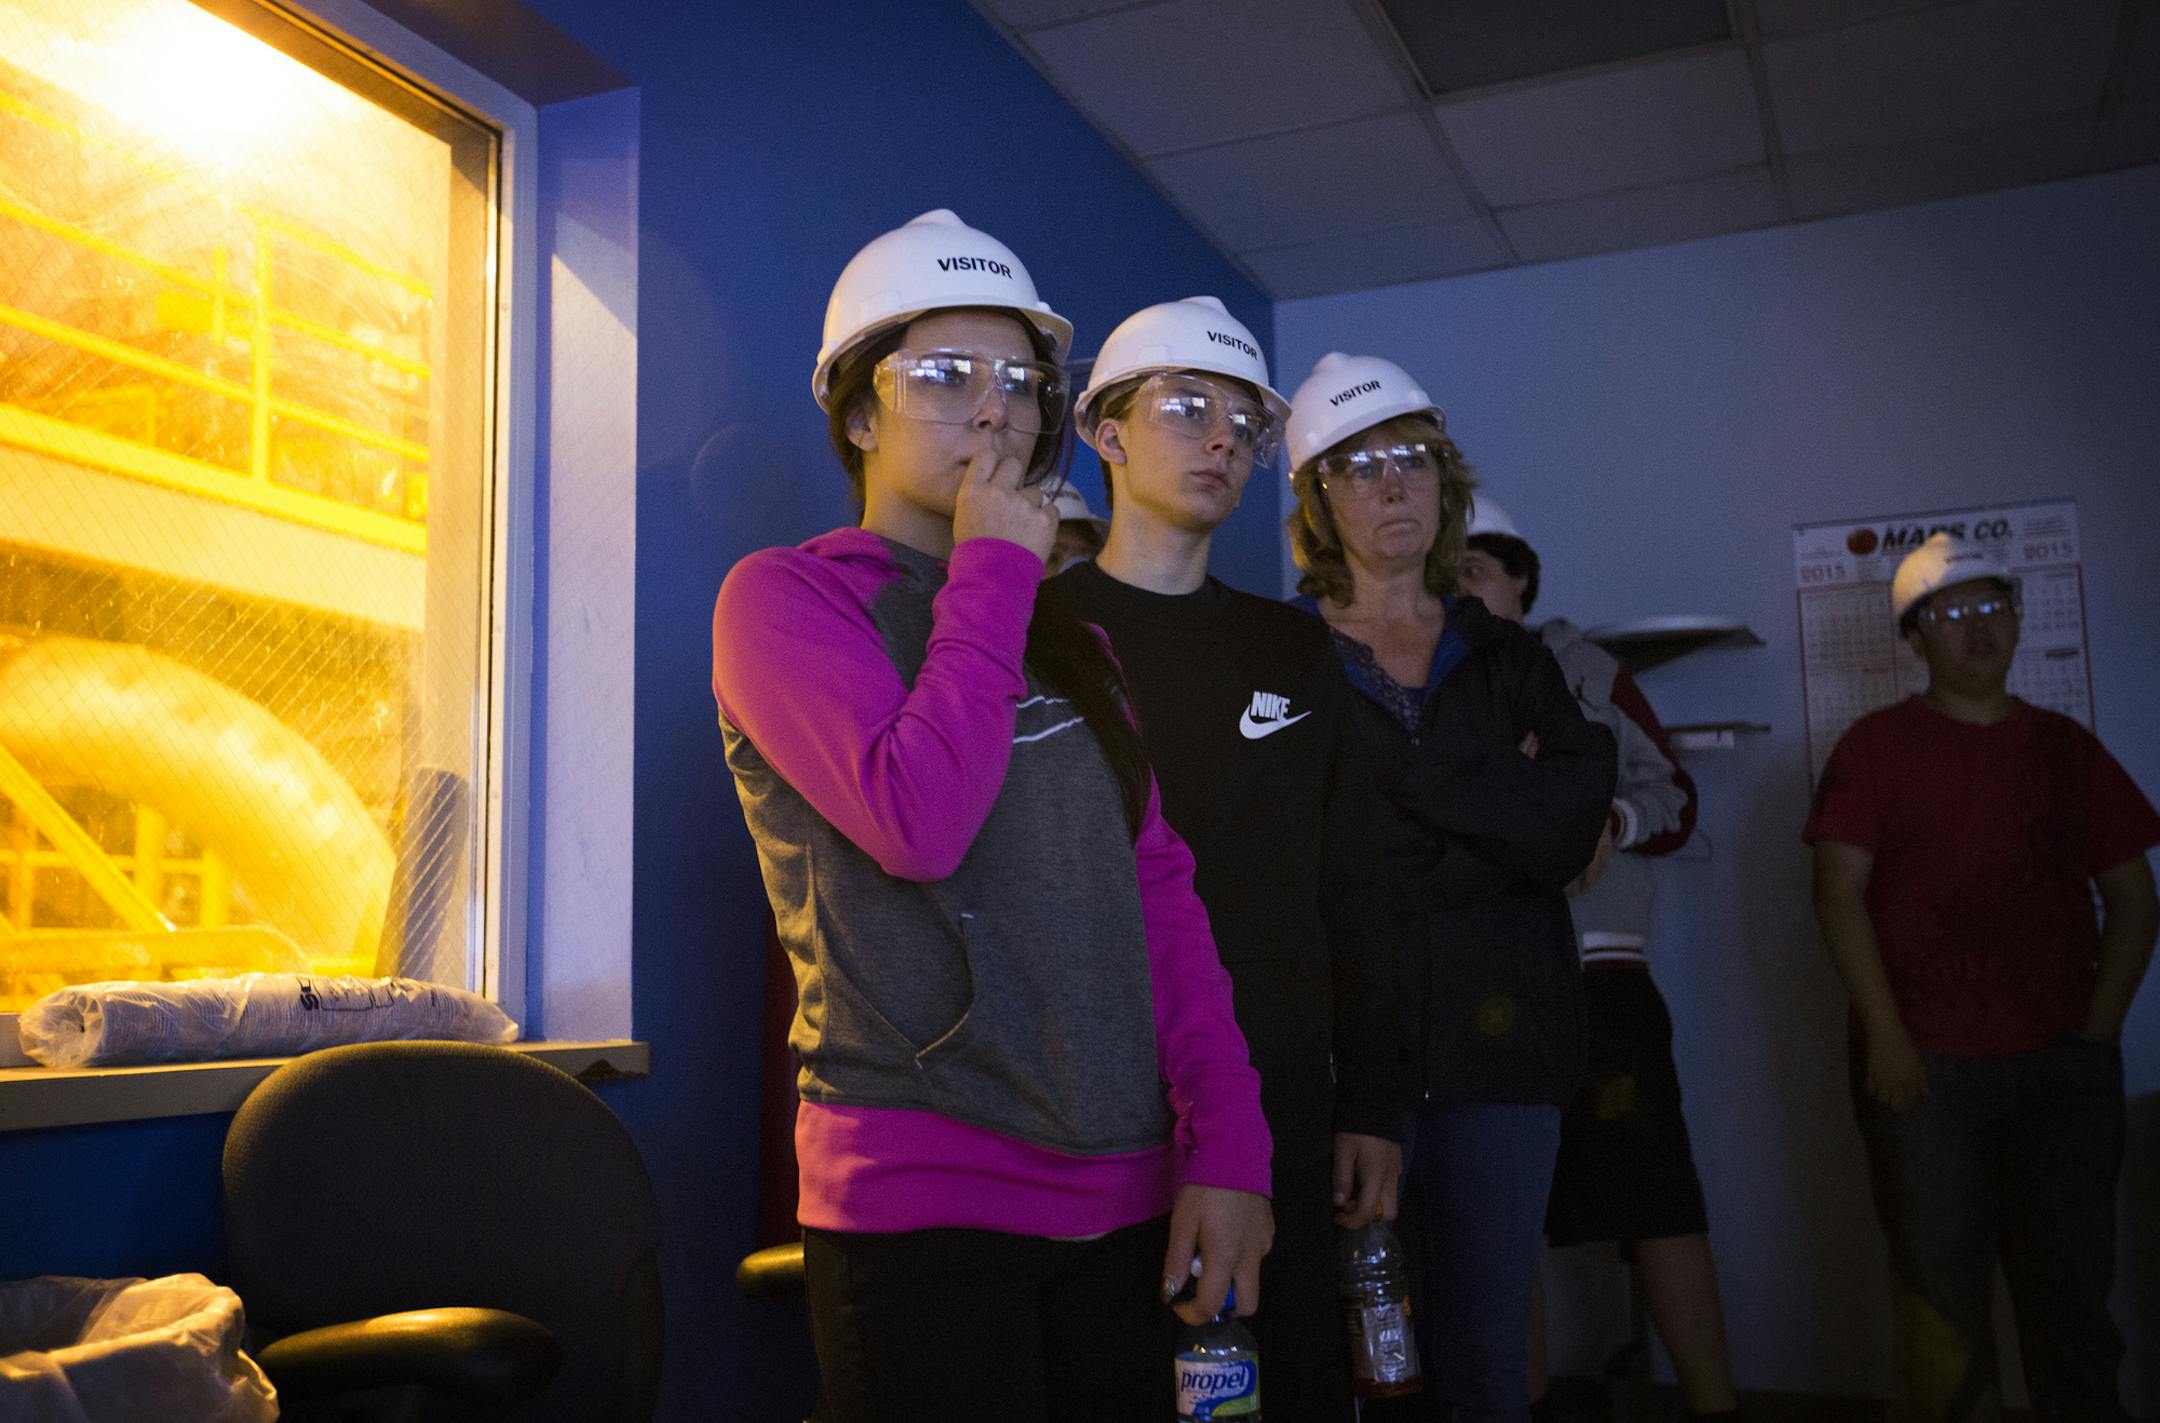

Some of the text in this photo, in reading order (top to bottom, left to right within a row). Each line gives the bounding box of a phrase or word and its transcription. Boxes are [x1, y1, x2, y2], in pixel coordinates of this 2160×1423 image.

[937, 256, 1013, 279] VISITOR
[1207, 330, 1258, 361] VISITOR
[1329, 380, 1382, 407] VISITOR
[2023, 542, 2073, 560] 2015
[1800, 564, 1846, 582] 2015
[1250, 690, 1292, 721] NIKE
[1181, 1365, 1246, 1393] propel
